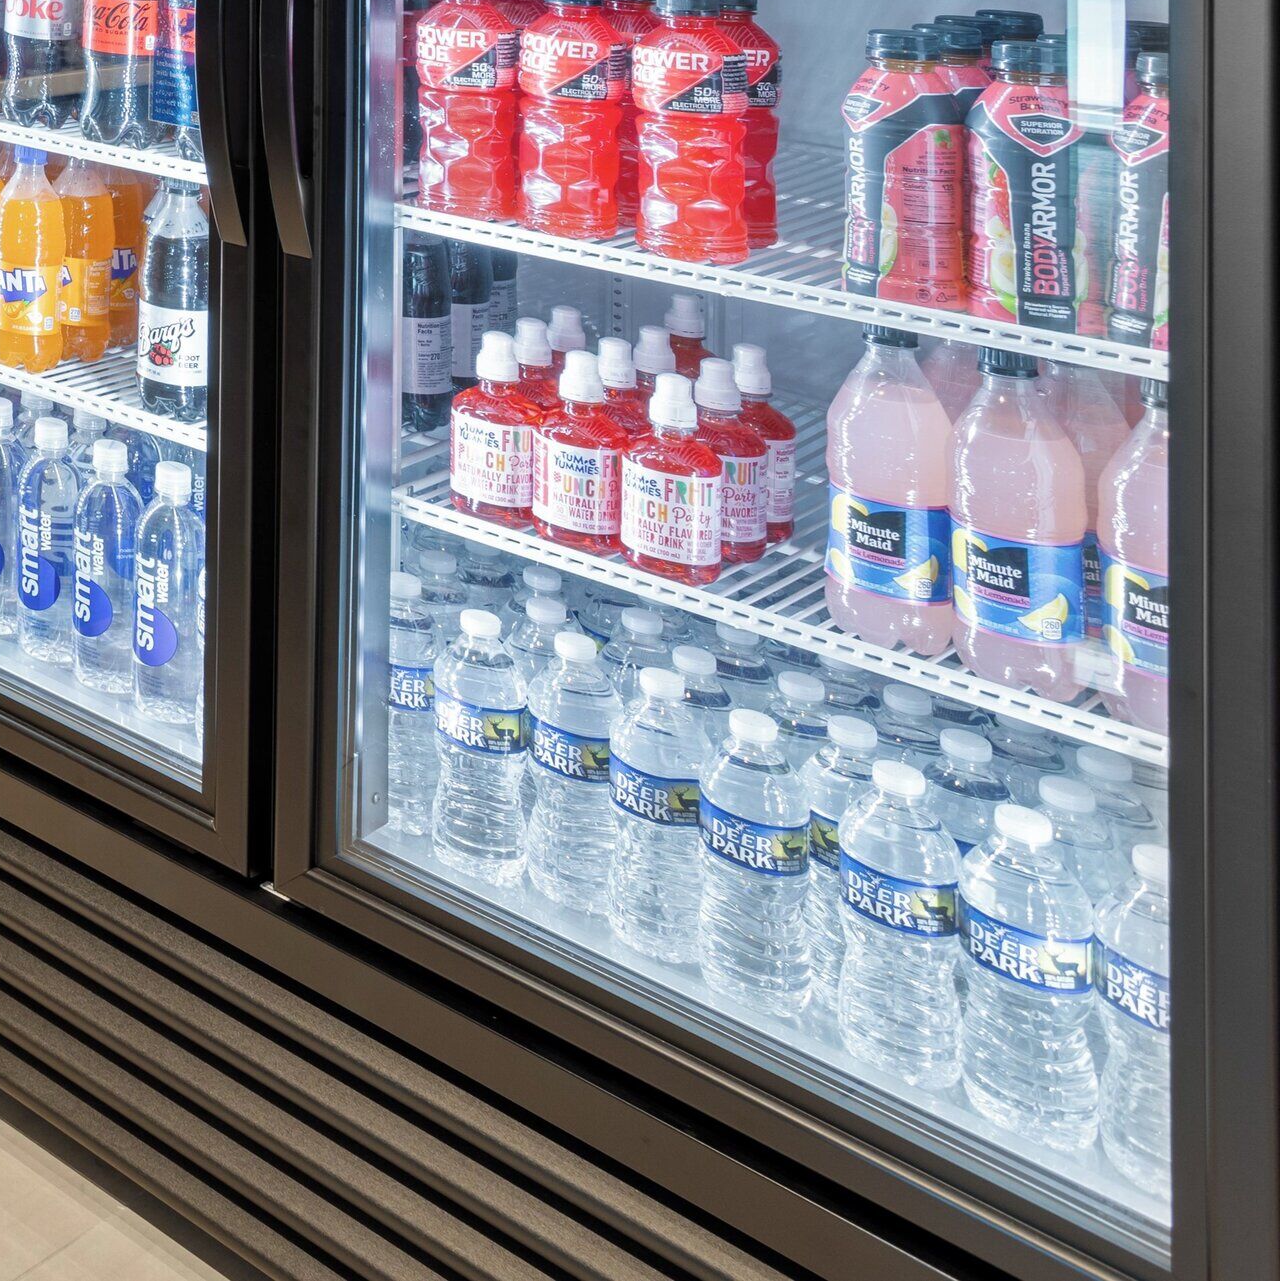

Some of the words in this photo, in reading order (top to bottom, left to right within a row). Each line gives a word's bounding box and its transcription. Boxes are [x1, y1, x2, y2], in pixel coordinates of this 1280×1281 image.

[418, 25, 486, 49] POWER
[524, 33, 598, 60] POWER
[633, 46, 709, 73] POWER
[1020, 120, 1063, 129] SUPERIOR
[1020, 127, 1064, 136] HYDRATION
[1032, 162, 1056, 297] BODYARMOR
[554, 455, 600, 475] YUMMIES
[553, 491, 603, 510] NATURALLY
[721, 486, 757, 506] Party
[568, 506, 595, 521] WATER
[721, 506, 758, 519] FLAVORED
[40, 511, 52, 551] water
[658, 535, 684, 550] DRINK
[850, 519, 901, 542] Minute
[856, 533, 892, 552] Maid
[19, 504, 39, 597] smart
[92, 534, 105, 576] water
[74, 526, 92, 623] smart
[970, 555, 1023, 579] Minute
[976, 569, 1015, 590] Maid
[156, 562, 170, 604] water
[135, 556, 155, 652] smart
[438, 700, 483, 732] DEER
[437, 718, 487, 748] PARK
[533, 732, 582, 760] DEER
[533, 748, 585, 777] PARK
[616, 773, 669, 806] DEER
[615, 789, 672, 822] PARK
[712, 817, 773, 853] DEER
[711, 836, 778, 872] PARK
[847, 869, 913, 910] DEER
[847, 888, 917, 929] PARK
[969, 919, 1040, 964] DEER
[969, 940, 1045, 984] PARK
